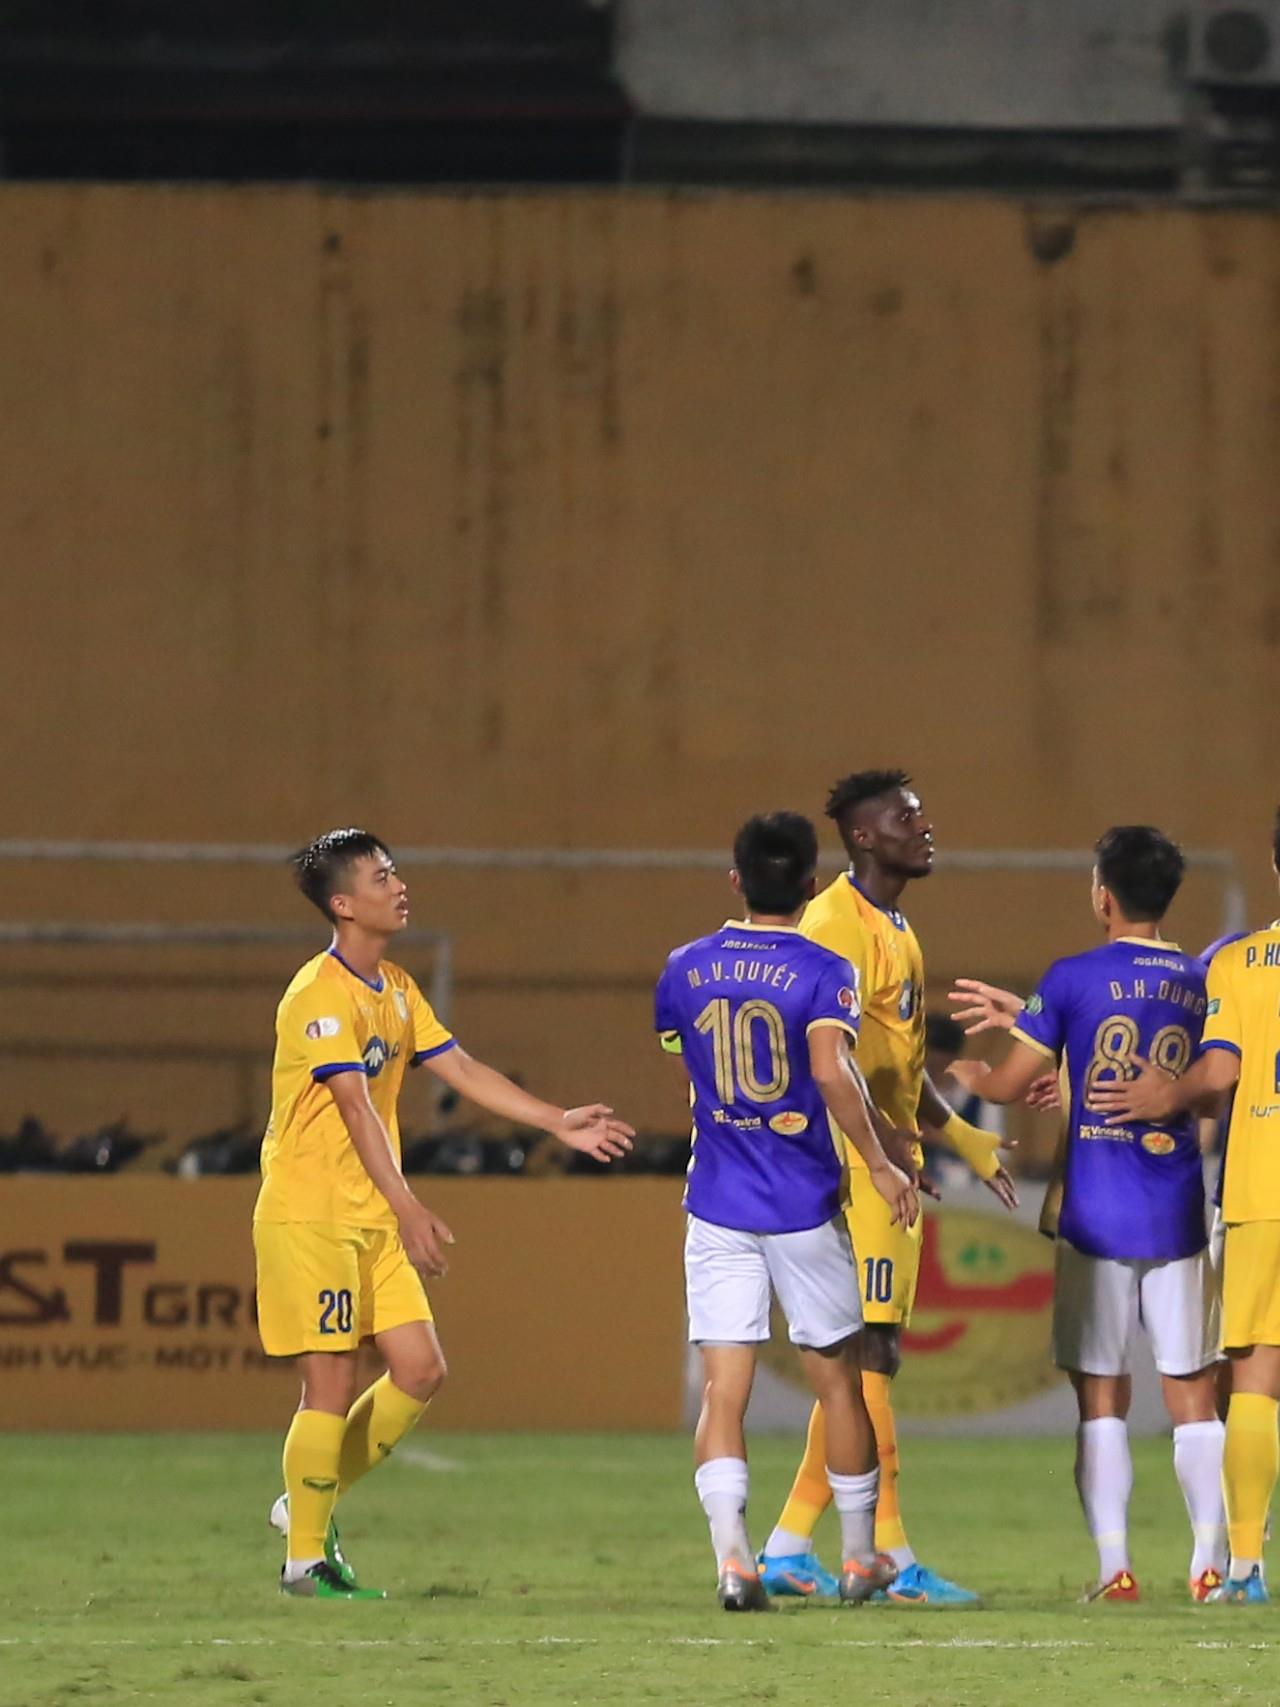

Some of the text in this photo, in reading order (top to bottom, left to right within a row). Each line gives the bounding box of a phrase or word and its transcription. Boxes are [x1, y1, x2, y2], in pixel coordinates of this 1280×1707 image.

[693, 998, 790, 1104] 10
[864, 1257, 894, 1303] 10
[144, 1283, 258, 1328] GR
[318, 1289, 353, 1334] 20
